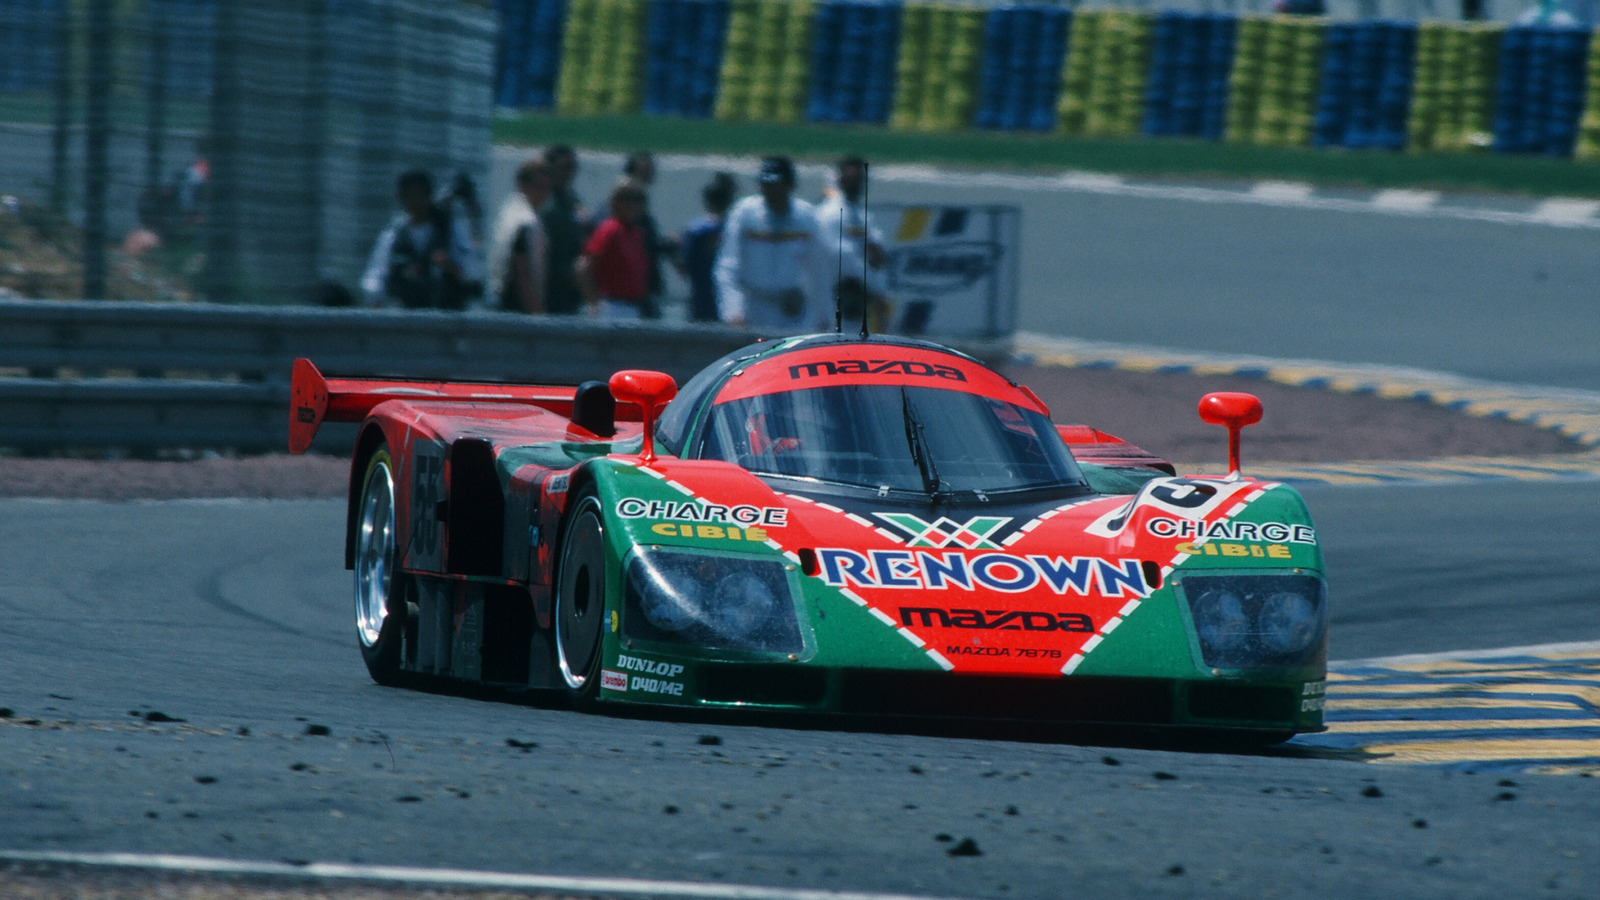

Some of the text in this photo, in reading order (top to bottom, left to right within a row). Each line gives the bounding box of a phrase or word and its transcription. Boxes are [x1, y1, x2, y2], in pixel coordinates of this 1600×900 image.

[788, 359, 968, 383] mazda
[616, 497, 788, 528] CHARGE
[1146, 517, 1317, 545] CHARGE
[814, 547, 1152, 599] RENOWN
[898, 606, 1096, 634] mazda
[946, 645, 1011, 657] MAZDA
[617, 654, 685, 678] DUNLOP
